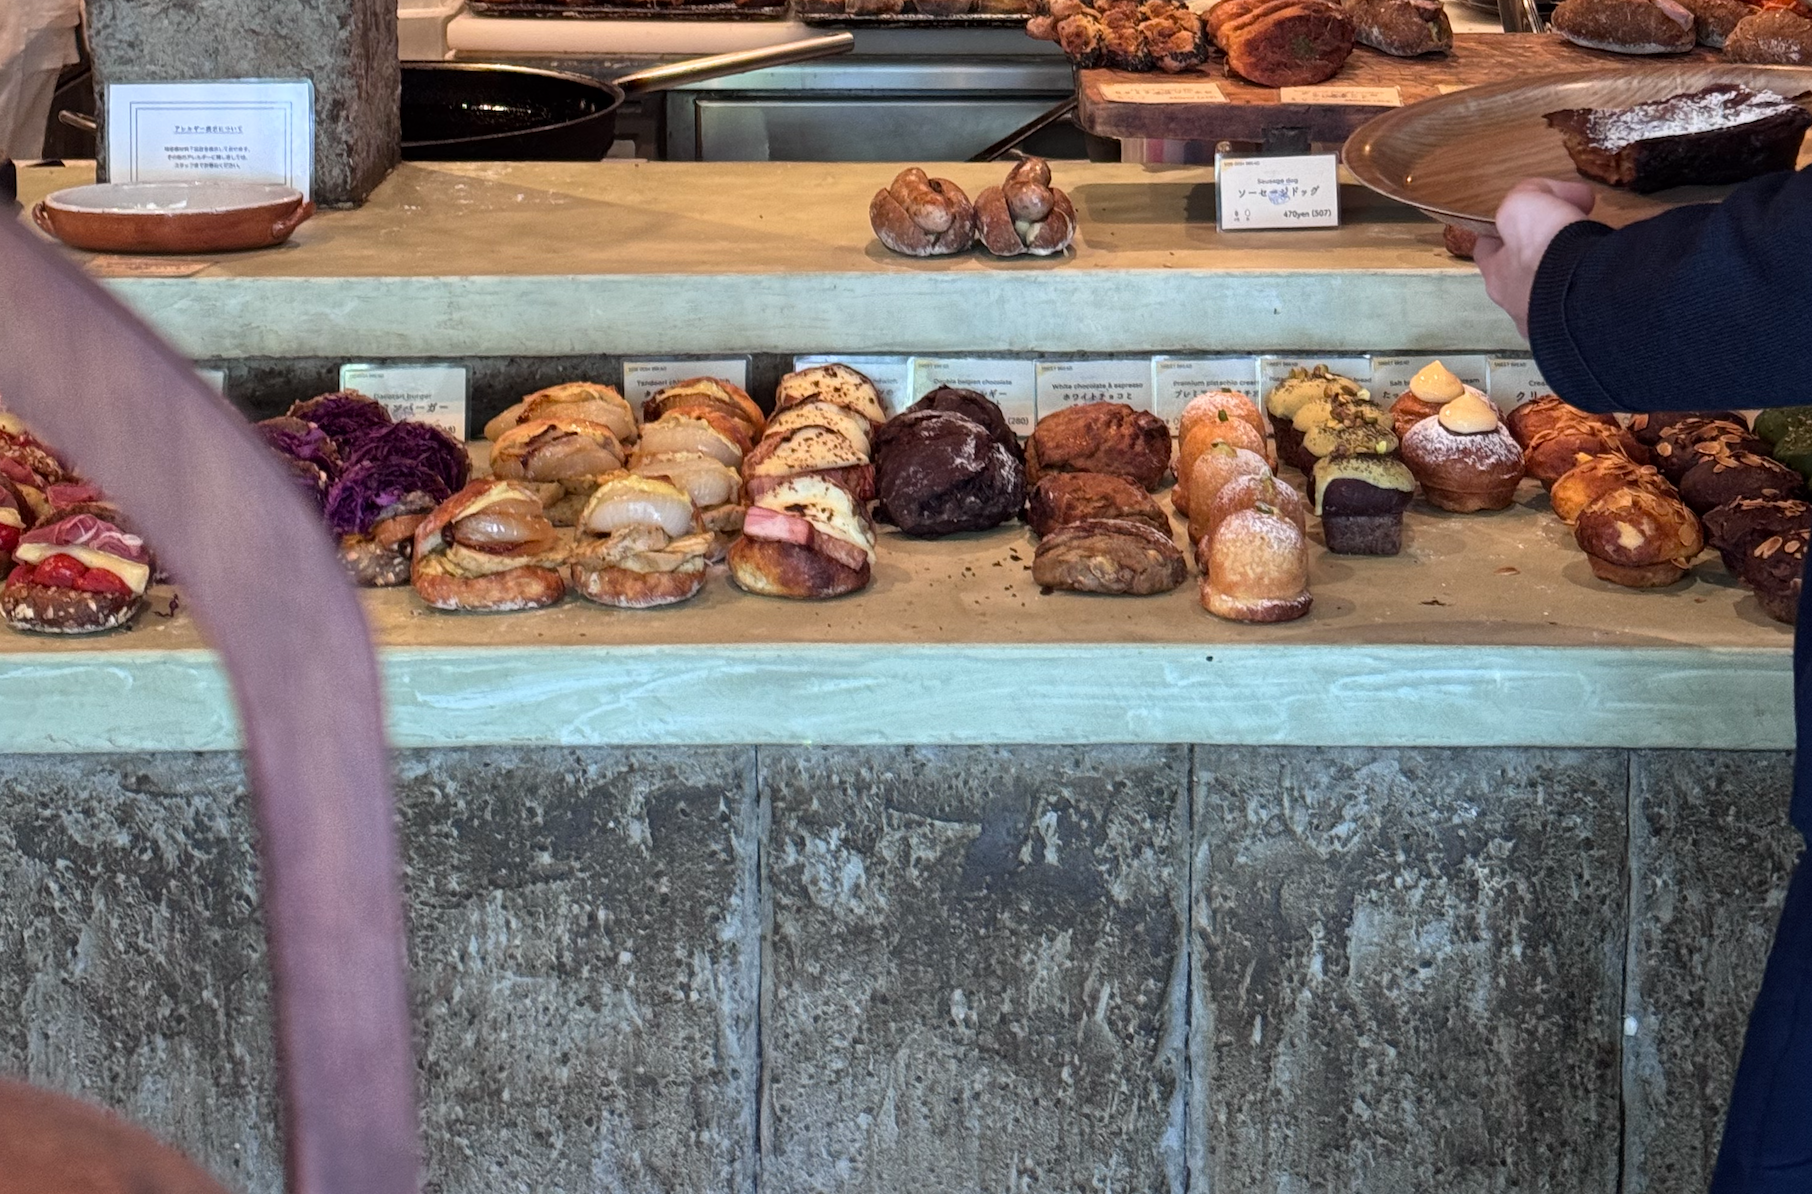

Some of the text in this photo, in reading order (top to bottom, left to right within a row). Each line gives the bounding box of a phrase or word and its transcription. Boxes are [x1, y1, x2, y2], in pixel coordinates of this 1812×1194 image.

[1286, 177, 1299, 185] dog
[1238, 185, 1320, 199] ソーセージドッグ
[1283, 208, 1332, 220] 470yen (507)
[1073, 382, 1106, 390] chocolate
[1206, 379, 1238, 387] pistachio
[1063, 392, 1132, 401] ホワイトチョコと
[1007, 416, 1029, 426] (280)
